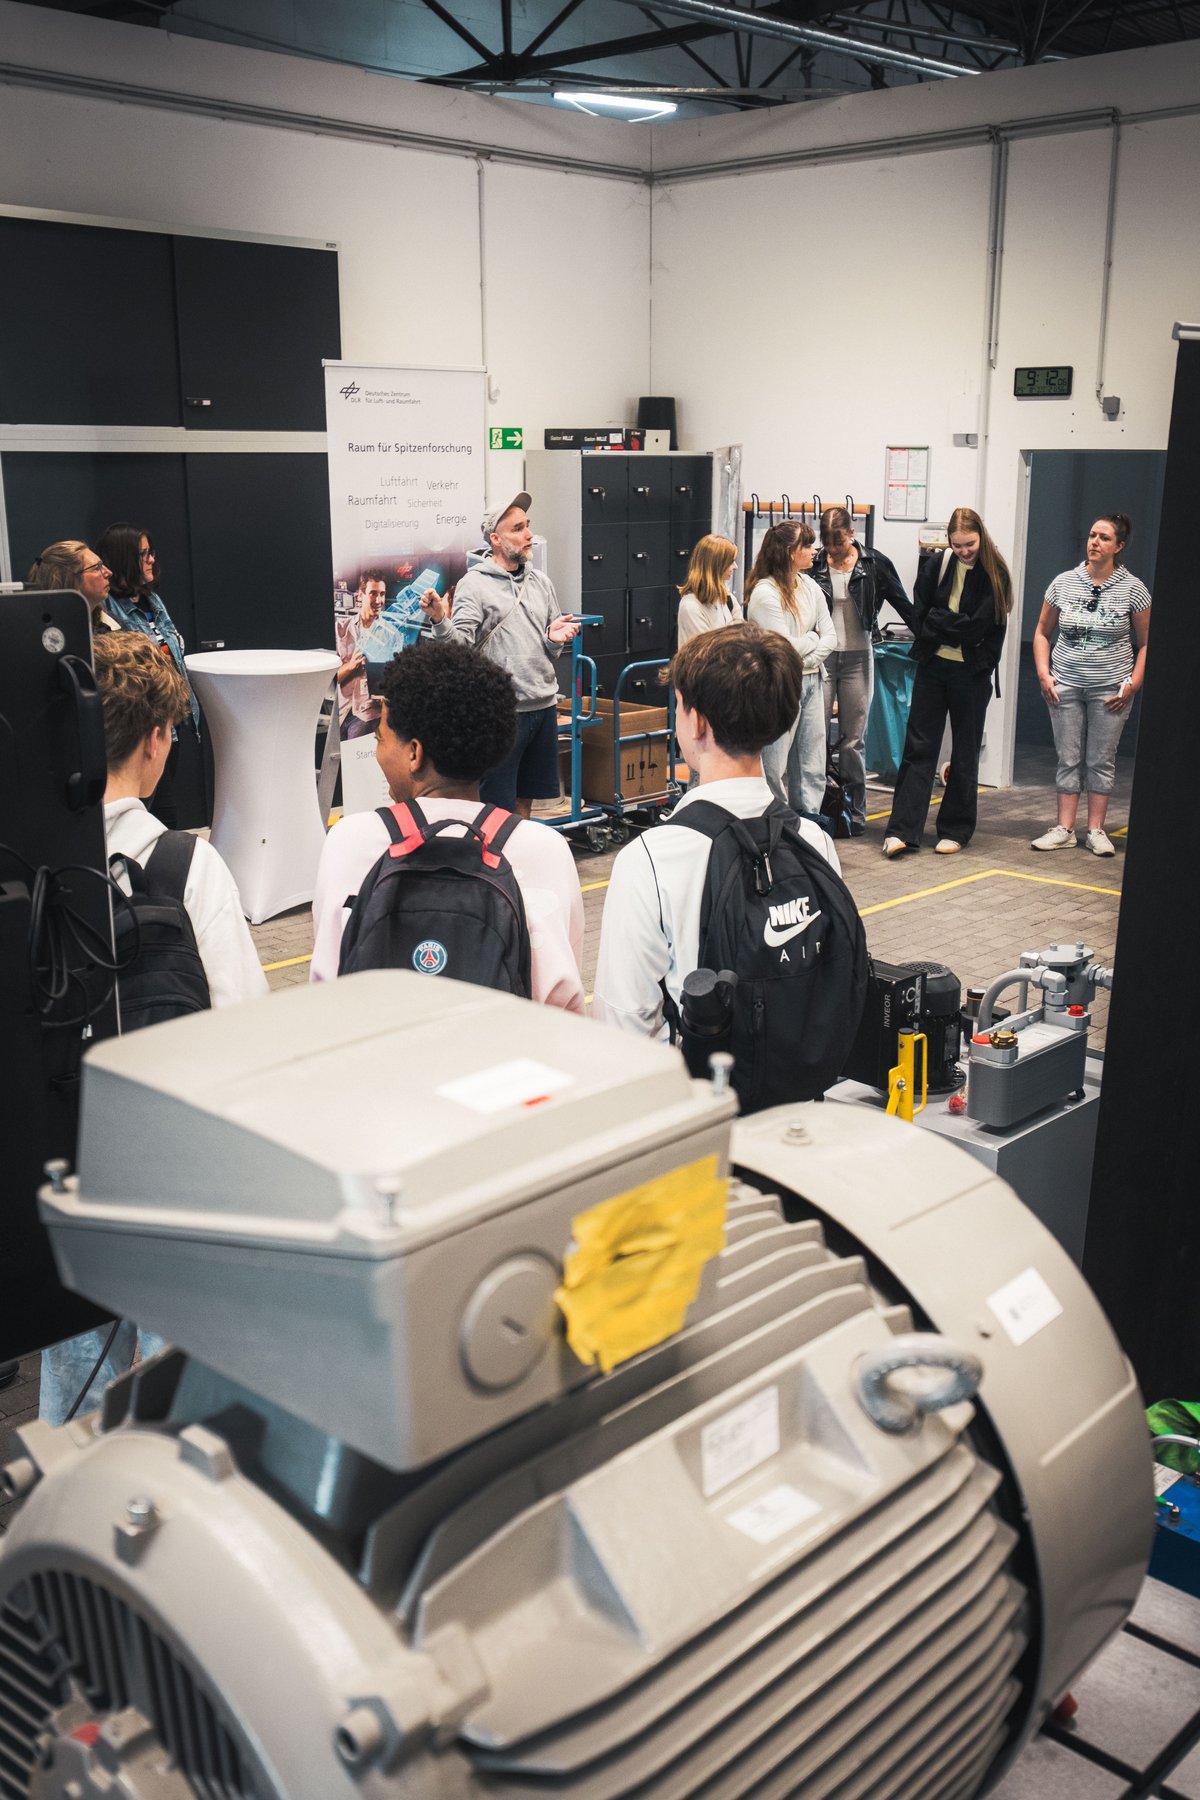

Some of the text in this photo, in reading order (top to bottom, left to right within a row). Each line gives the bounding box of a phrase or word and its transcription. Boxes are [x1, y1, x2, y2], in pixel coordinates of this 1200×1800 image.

[1027, 371, 1059, 386] 9:12
[348, 442, 473, 455] Raum für Spitzenforschung
[380, 476, 418, 487] Luftfahrt
[426, 480, 459, 490] Verkehr
[348, 494, 397, 506] Raumfahrt
[407, 498, 443, 508] Sicherheit
[365, 518, 419, 530] Digitalisierung
[436, 514, 467, 526] Energie
[769, 896, 810, 927] NIKE
[883, 994, 892, 1028] INVEOR
